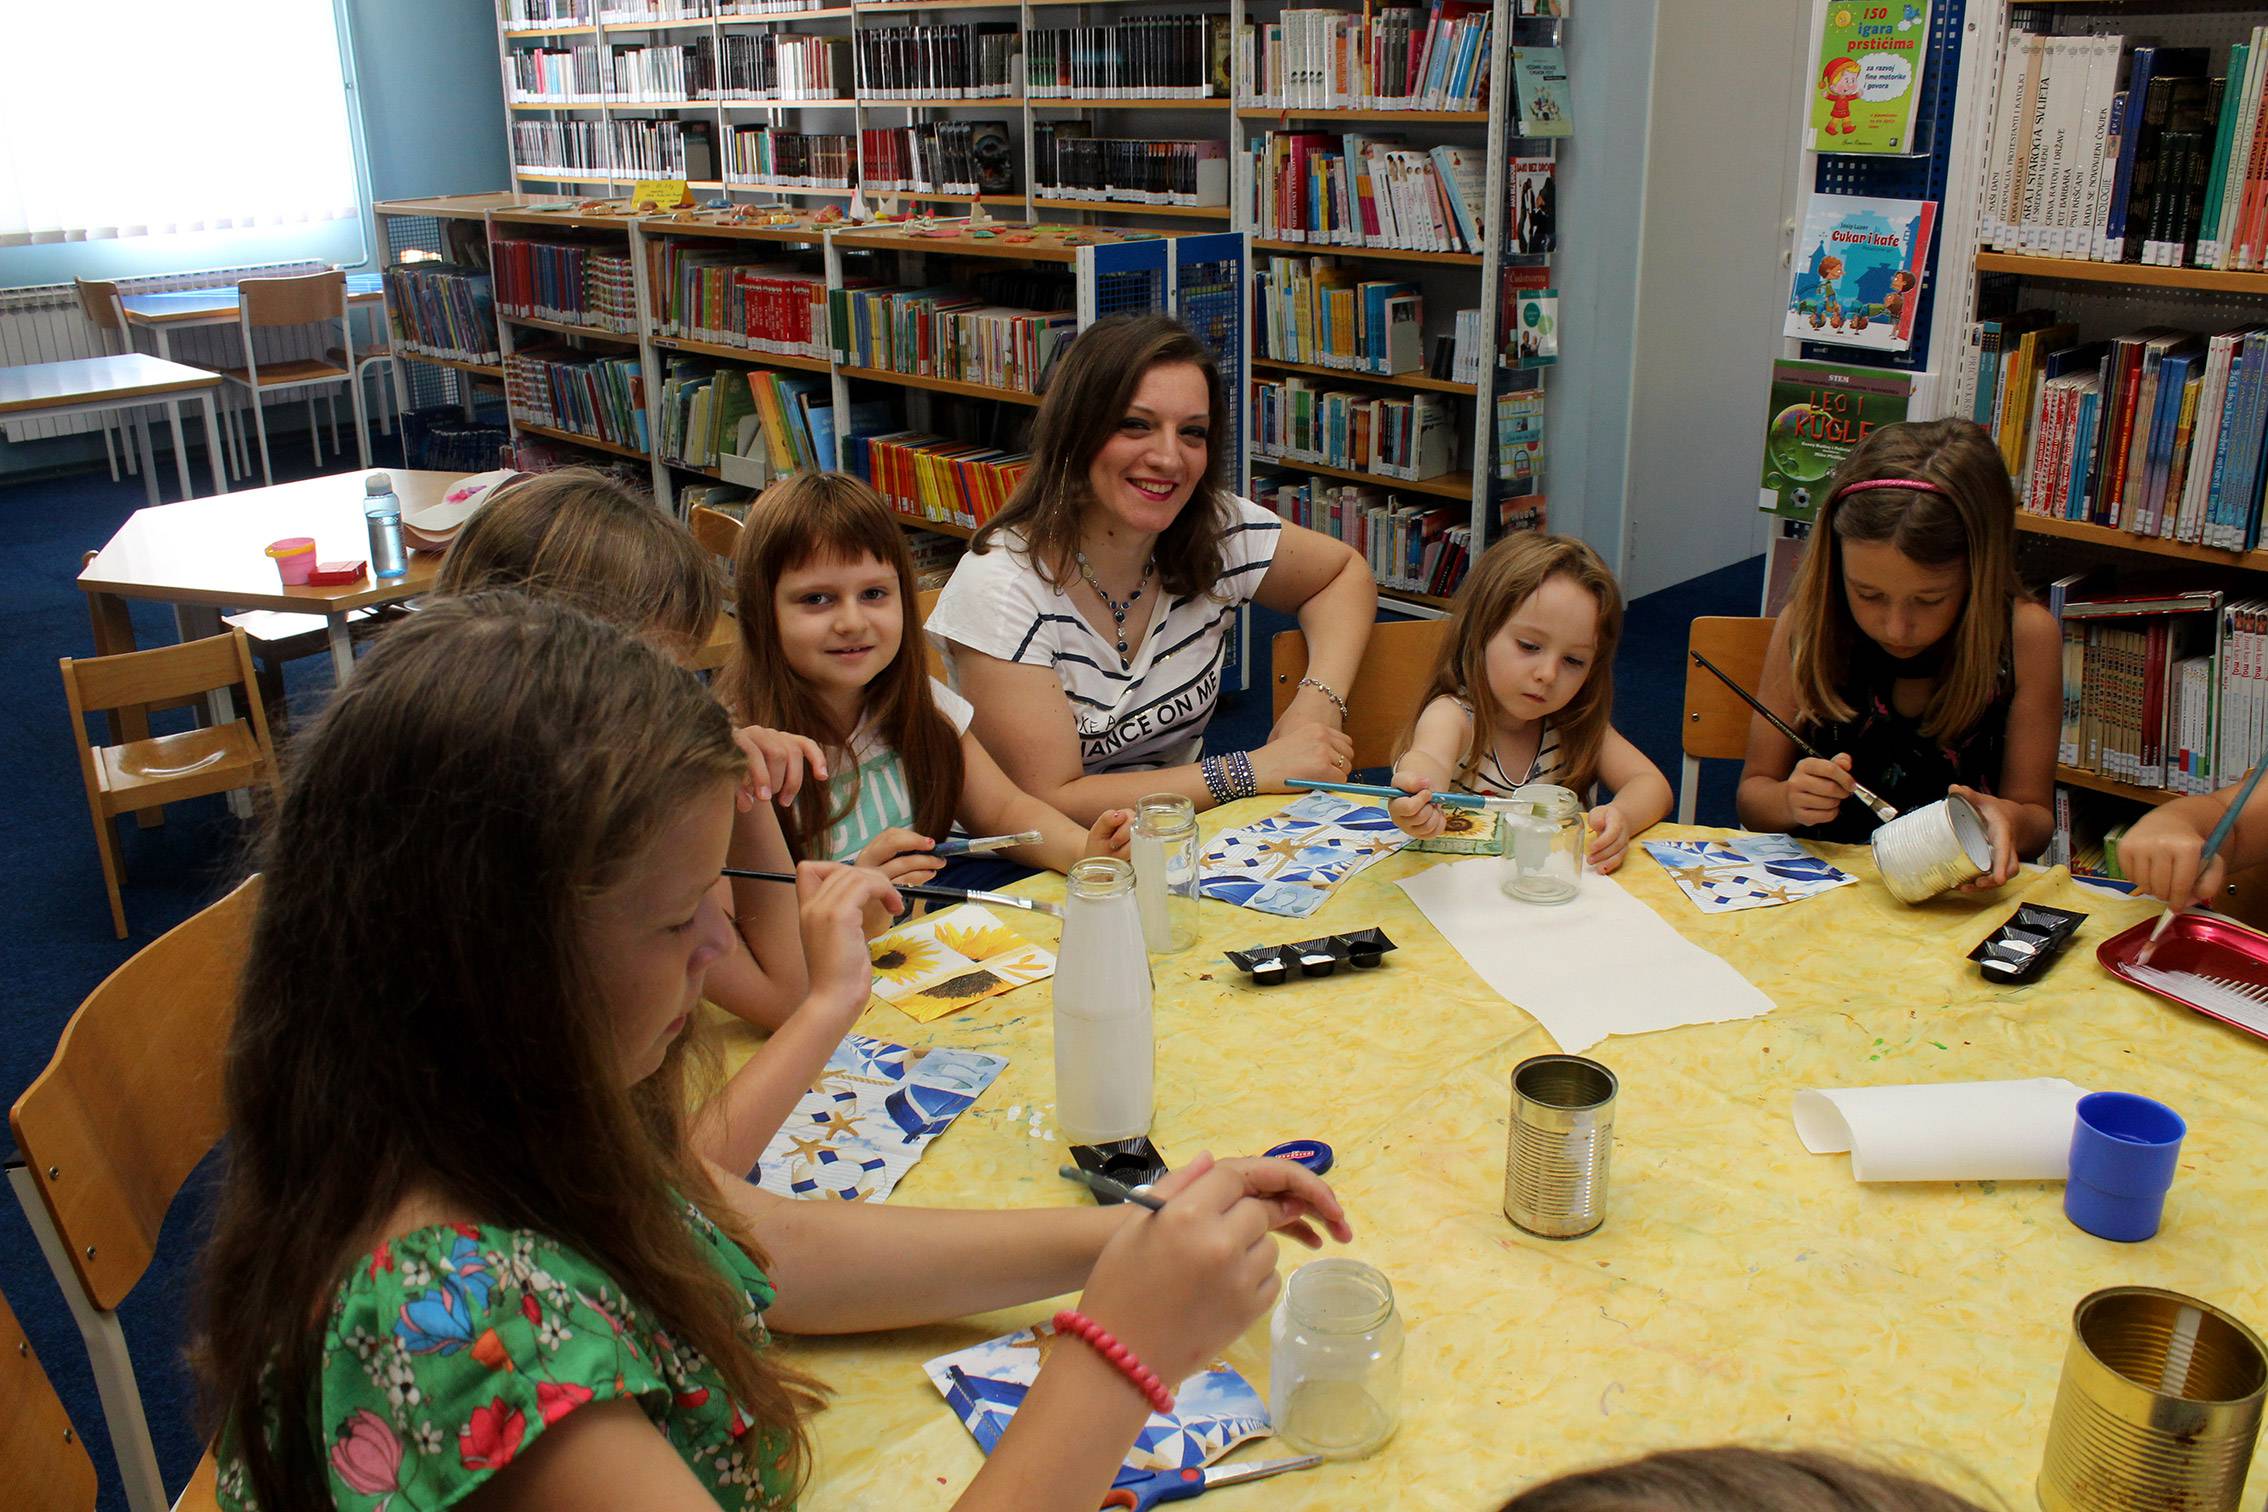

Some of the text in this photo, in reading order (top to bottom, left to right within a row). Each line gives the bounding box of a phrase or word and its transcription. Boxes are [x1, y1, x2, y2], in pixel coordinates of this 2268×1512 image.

[1863, 8, 1888, 19] 150
[1858, 23, 1893, 37] igara
[1847, 36, 1915, 52] prstićima
[2015, 74, 2025, 108] KATOLICI
[2022, 77, 2050, 220] KRAJ STAROGA SVIJETA
[2052, 128, 2065, 160] DRŽAVE
[1991, 172, 1999, 191] DANI
[2057, 168, 2071, 226] PUT BARBARA
[2086, 191, 2093, 200] SE
[2096, 178, 2111, 227] MITOLOGIJE
[1832, 230, 1900, 246] Cukar i kafe
[1828, 374, 1849, 383] STEM
[1810, 390, 1864, 416] LEO I
[1794, 414, 1875, 443] KUGLE
[2241, 664, 2249, 678] moj
[2253, 666, 2262, 680] moj
[1157, 694, 1192, 725] ON
[1197, 671, 1217, 704] ME
